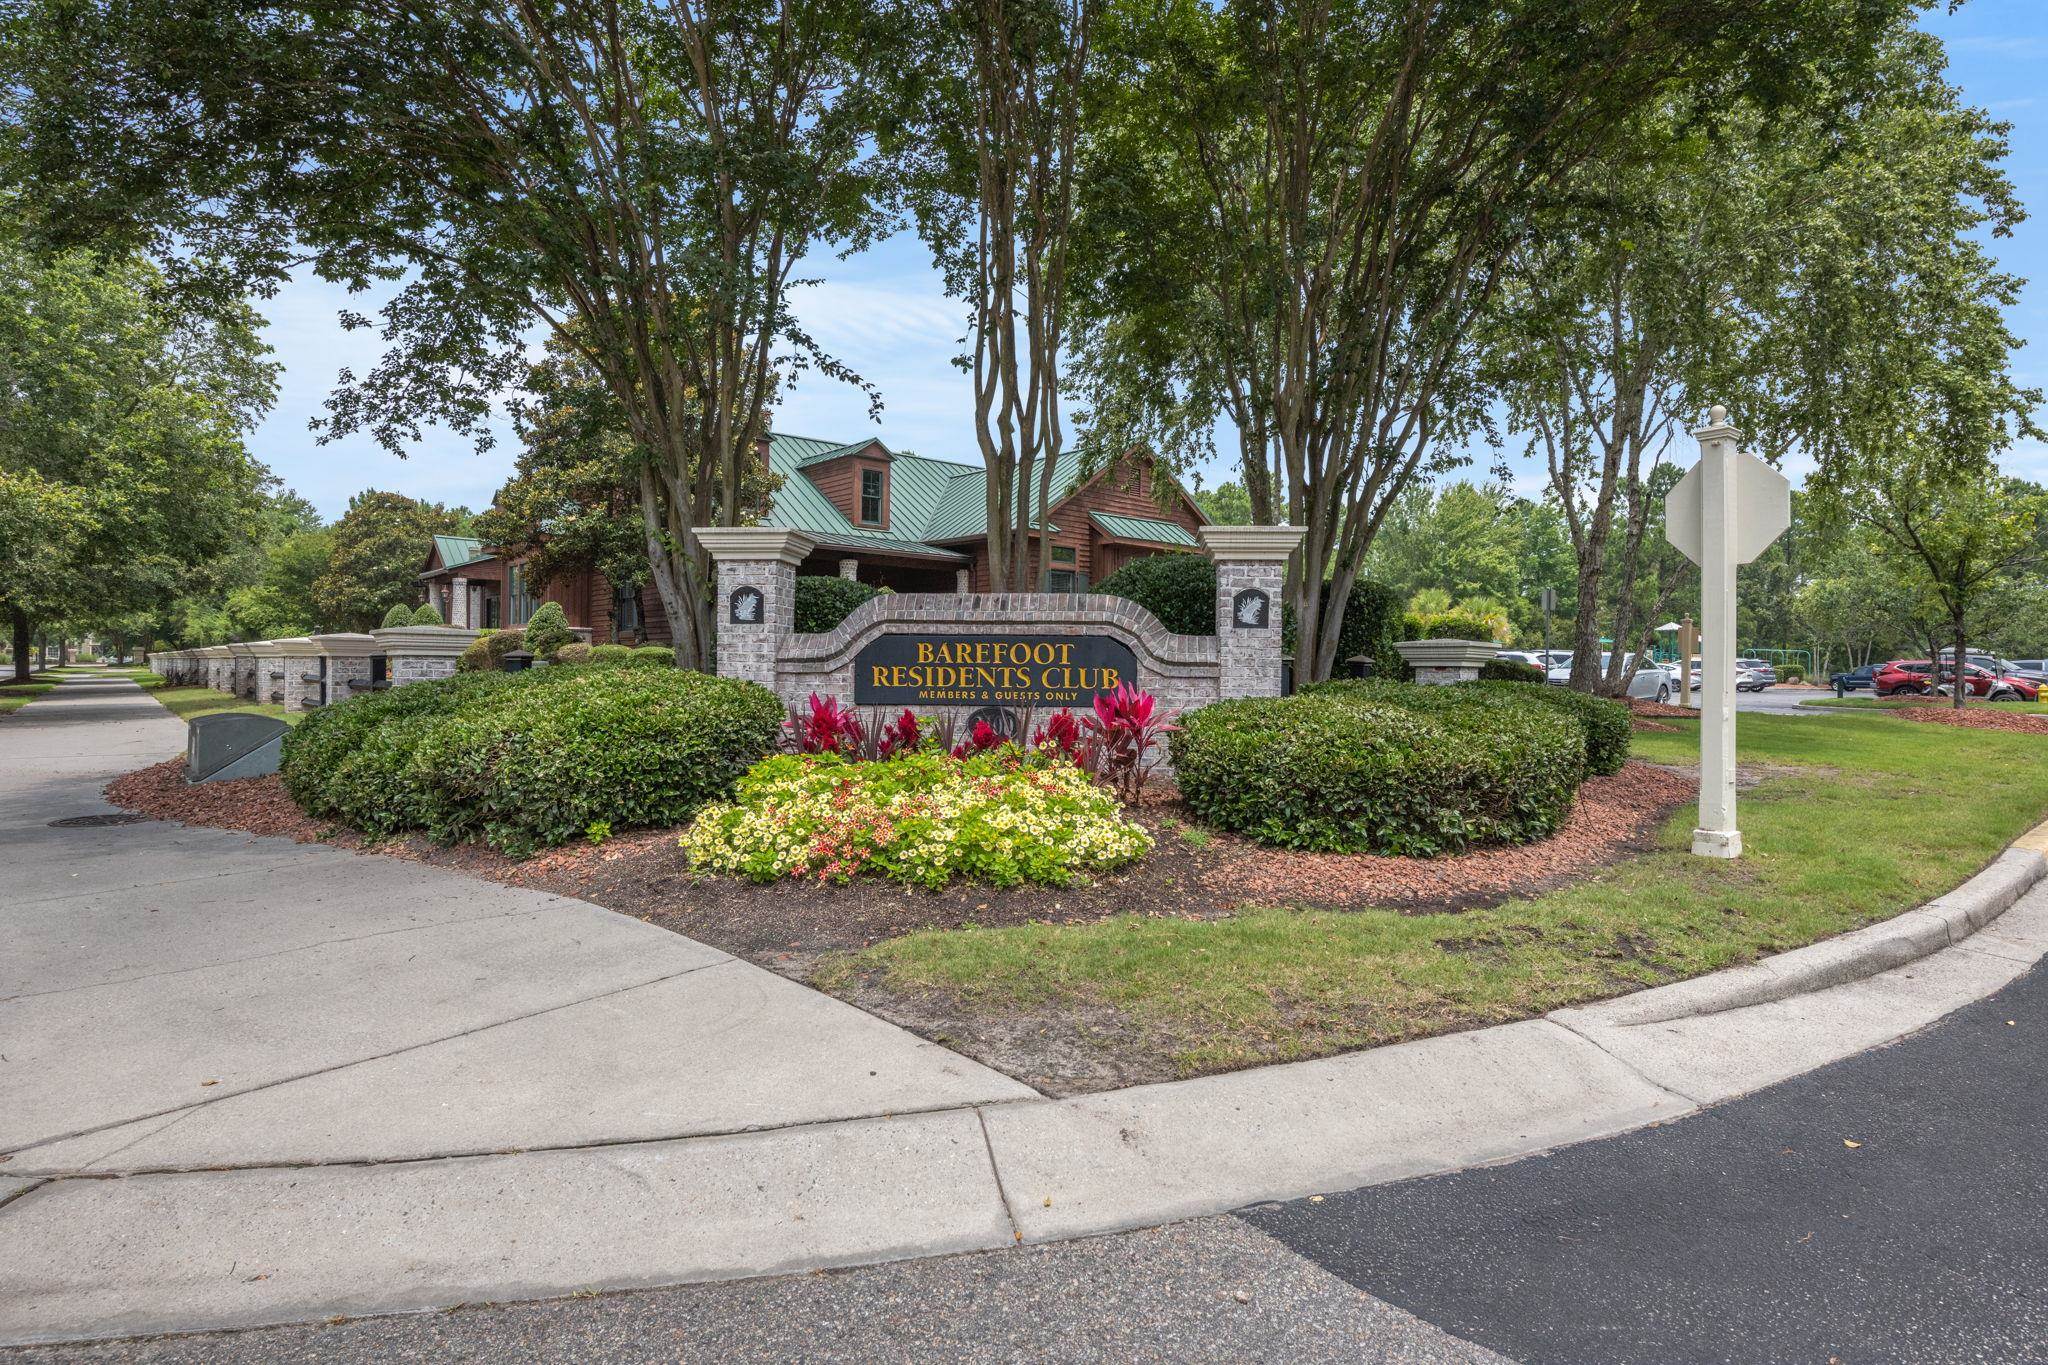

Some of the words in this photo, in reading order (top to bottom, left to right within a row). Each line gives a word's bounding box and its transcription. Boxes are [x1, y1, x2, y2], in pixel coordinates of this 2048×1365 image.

[917, 642, 1075, 665] BAREFOOT
[872, 666, 1031, 688] RESIDENTS
[1041, 667, 1119, 690] CLUB
[919, 690, 976, 700] MEMBERS
[981, 690, 989, 700] &
[995, 691, 1040, 701] GUESTS
[1045, 691, 1078, 701] ONLY
